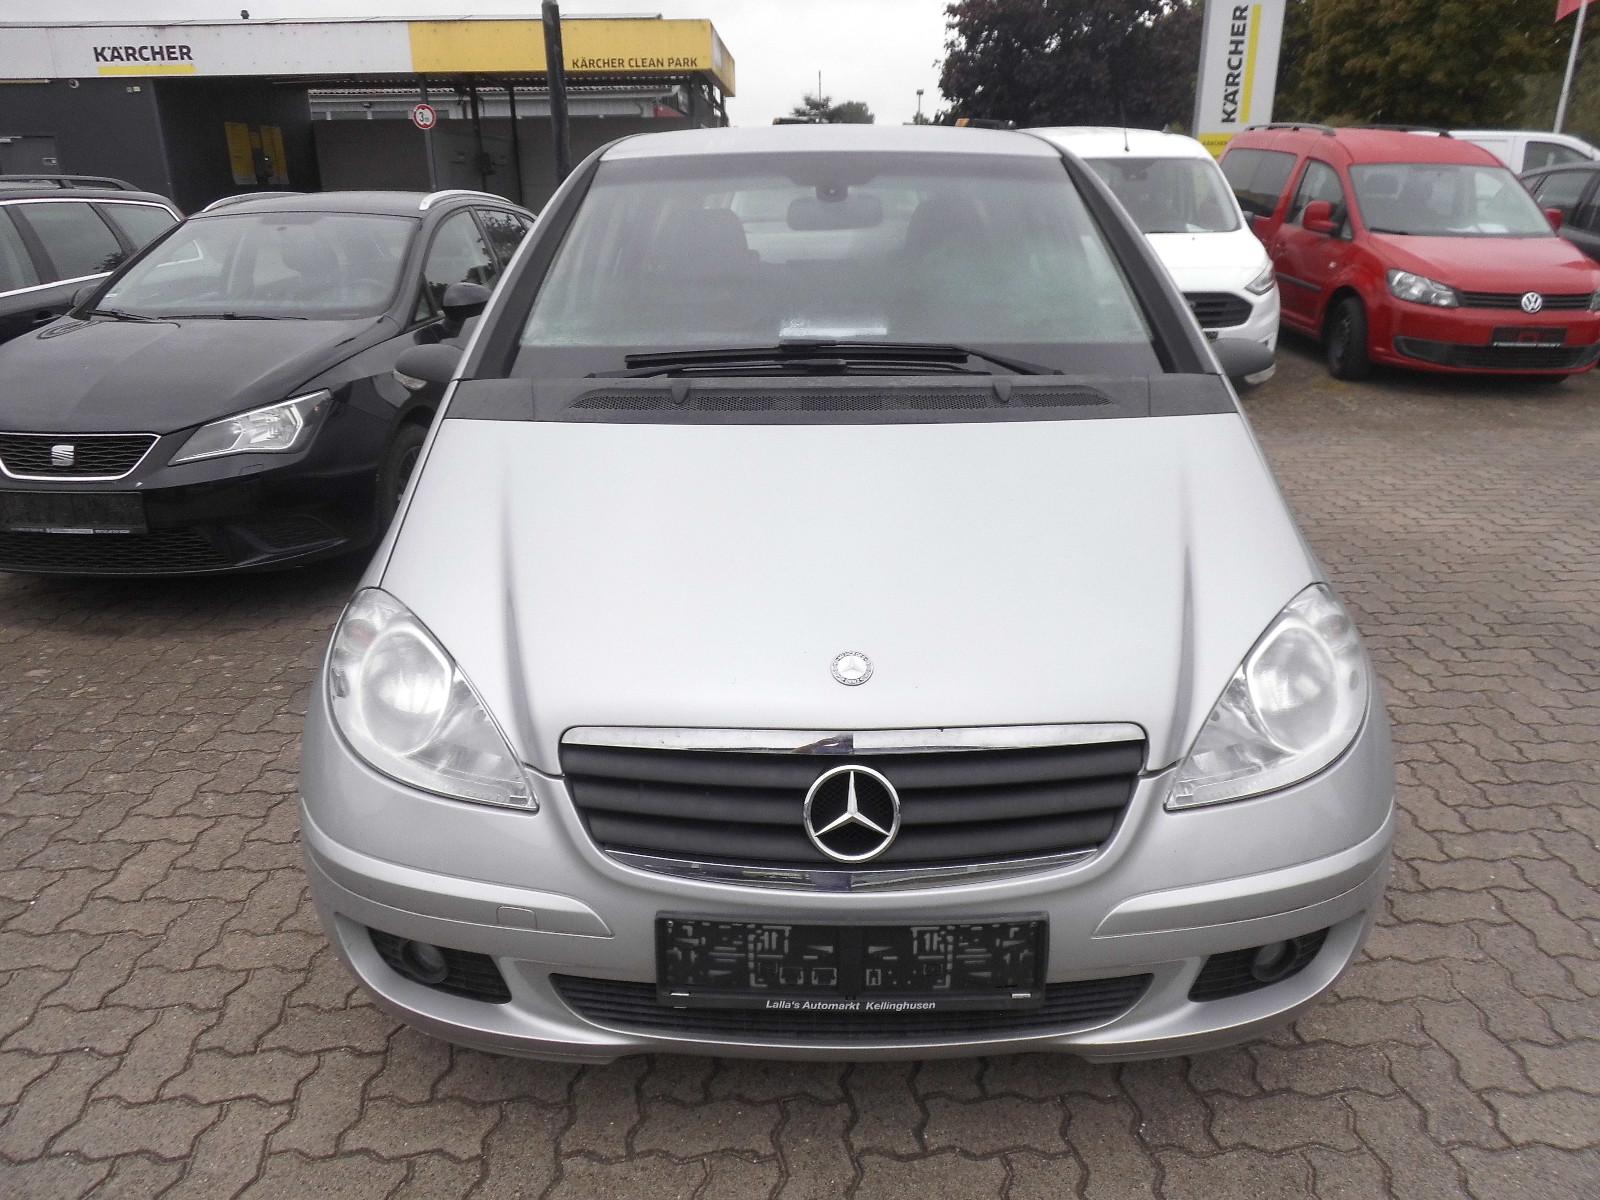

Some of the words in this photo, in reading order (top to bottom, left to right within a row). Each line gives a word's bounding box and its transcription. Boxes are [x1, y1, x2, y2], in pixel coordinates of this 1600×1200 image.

[93, 45, 193, 62] KÄRCHER
[572, 57, 625, 69] KÄRCHER
[628, 58, 664, 68] CLEAN
[667, 57, 698, 67] PARK
[1221, 4, 1249, 123] KÄRCHER
[802, 1001, 860, 1010] Automarkt
[865, 1001, 936, 1011] Kellinghusen
